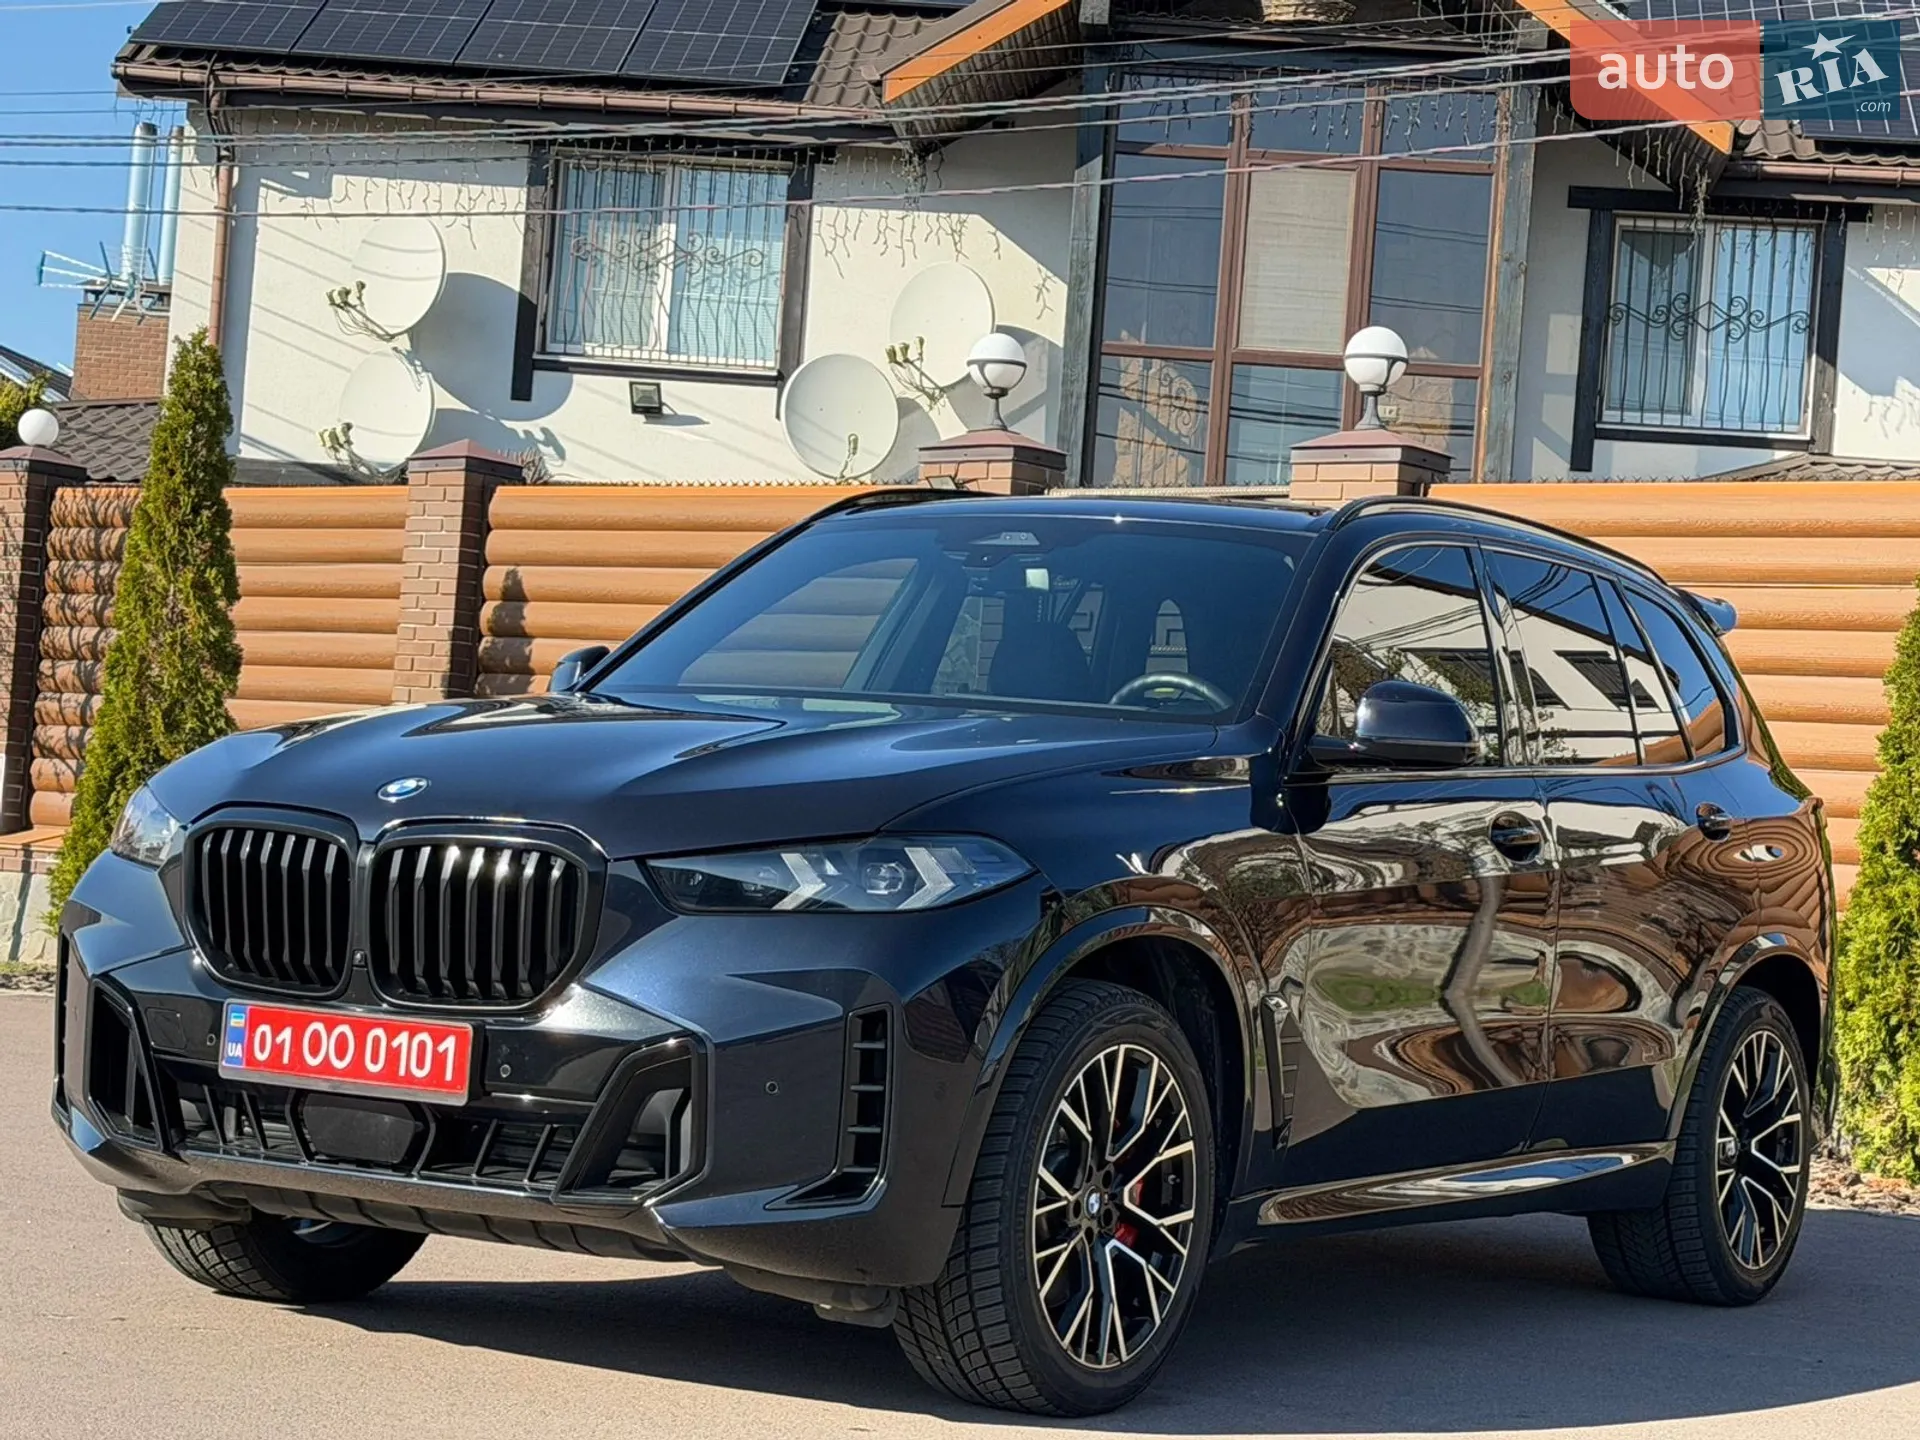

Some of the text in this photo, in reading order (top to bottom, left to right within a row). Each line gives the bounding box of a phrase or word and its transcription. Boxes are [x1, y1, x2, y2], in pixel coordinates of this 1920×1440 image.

[227, 1042, 243, 1058] UA
[253, 1024, 292, 1064] 01
[364, 1027, 456, 1081] 0101
